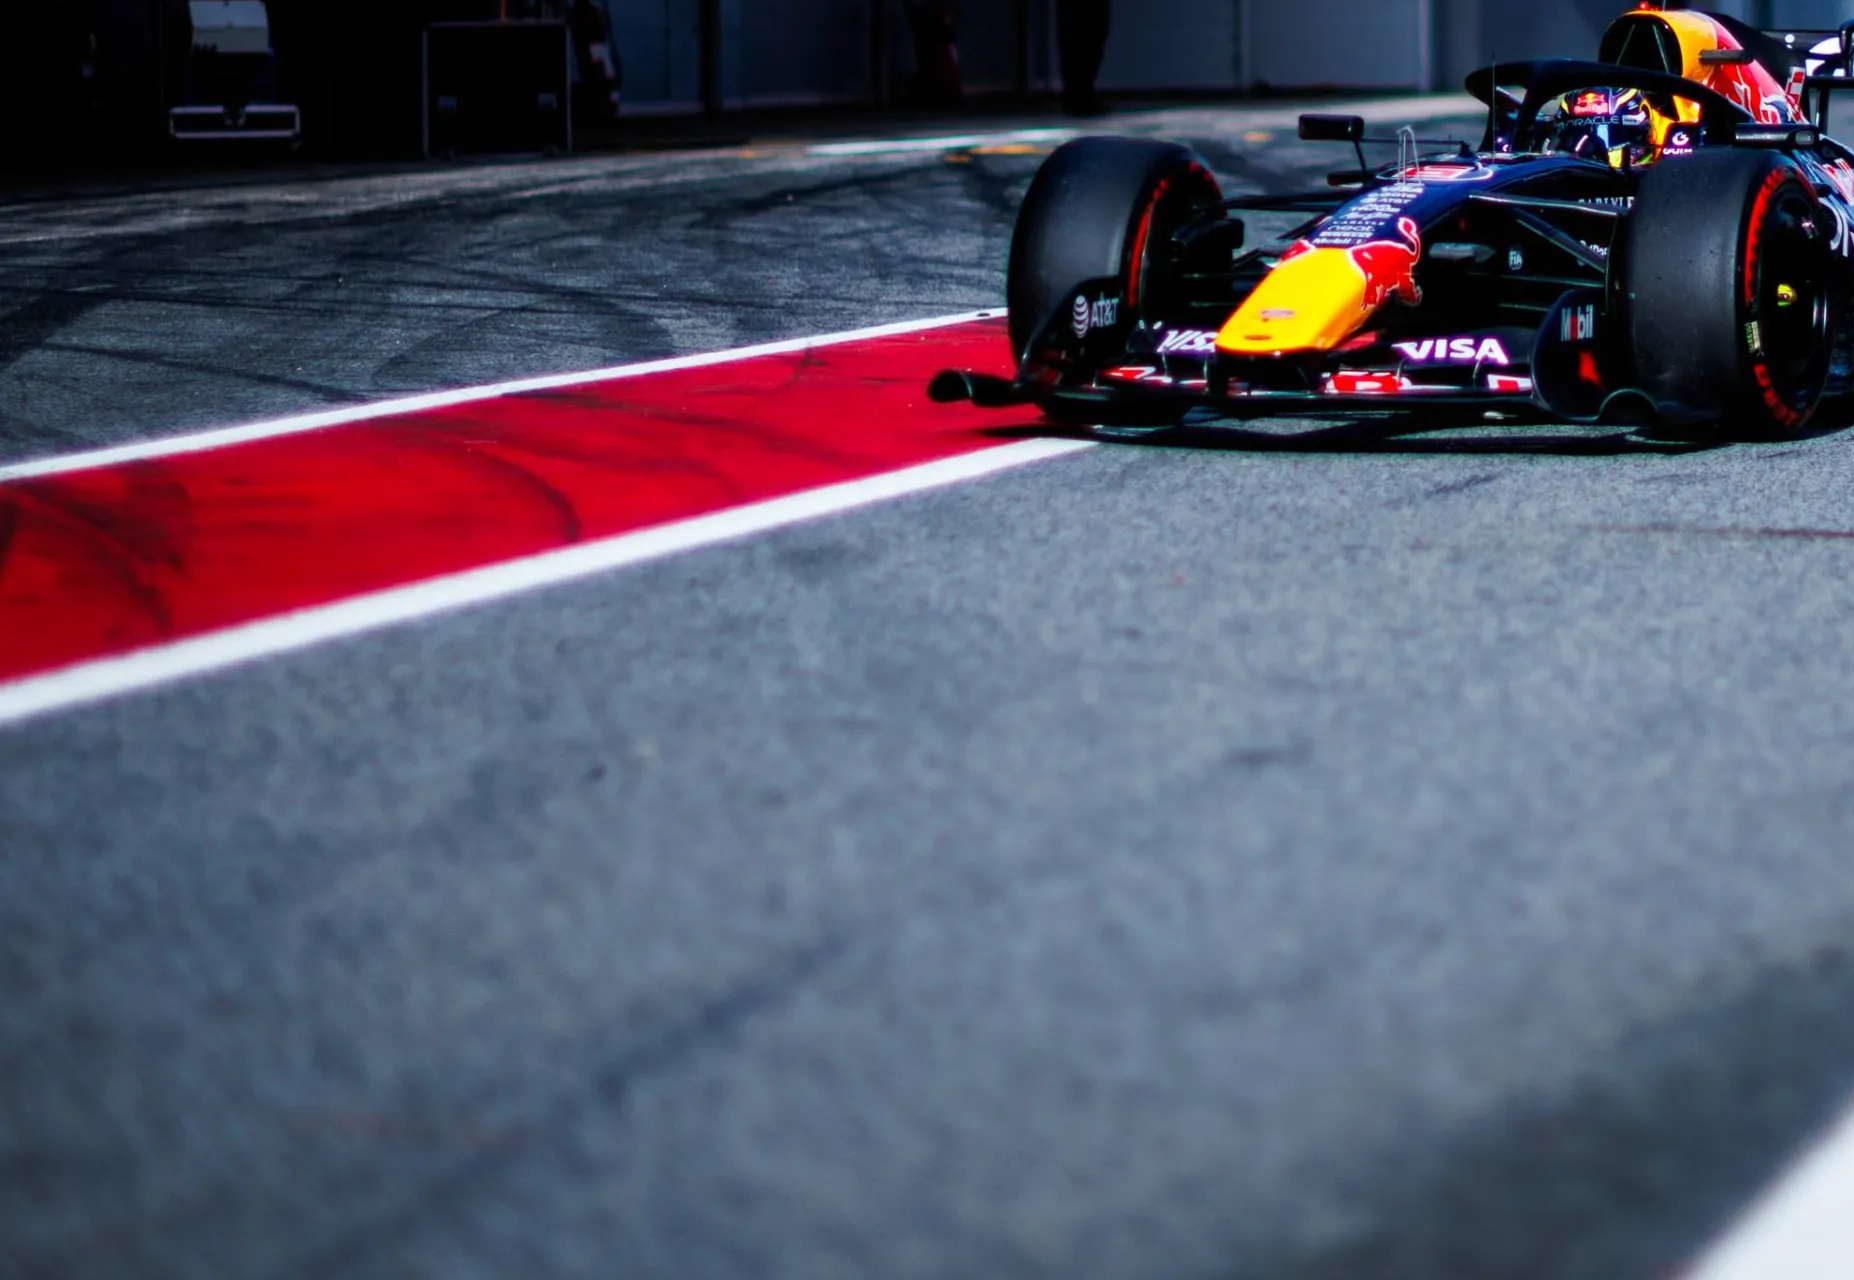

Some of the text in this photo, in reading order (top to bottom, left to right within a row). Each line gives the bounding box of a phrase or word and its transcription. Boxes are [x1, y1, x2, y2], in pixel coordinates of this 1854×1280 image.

[1090, 298, 1119, 328] AT&T
[1560, 304, 1594, 342] Mobil
[1390, 338, 1508, 364] VISA
